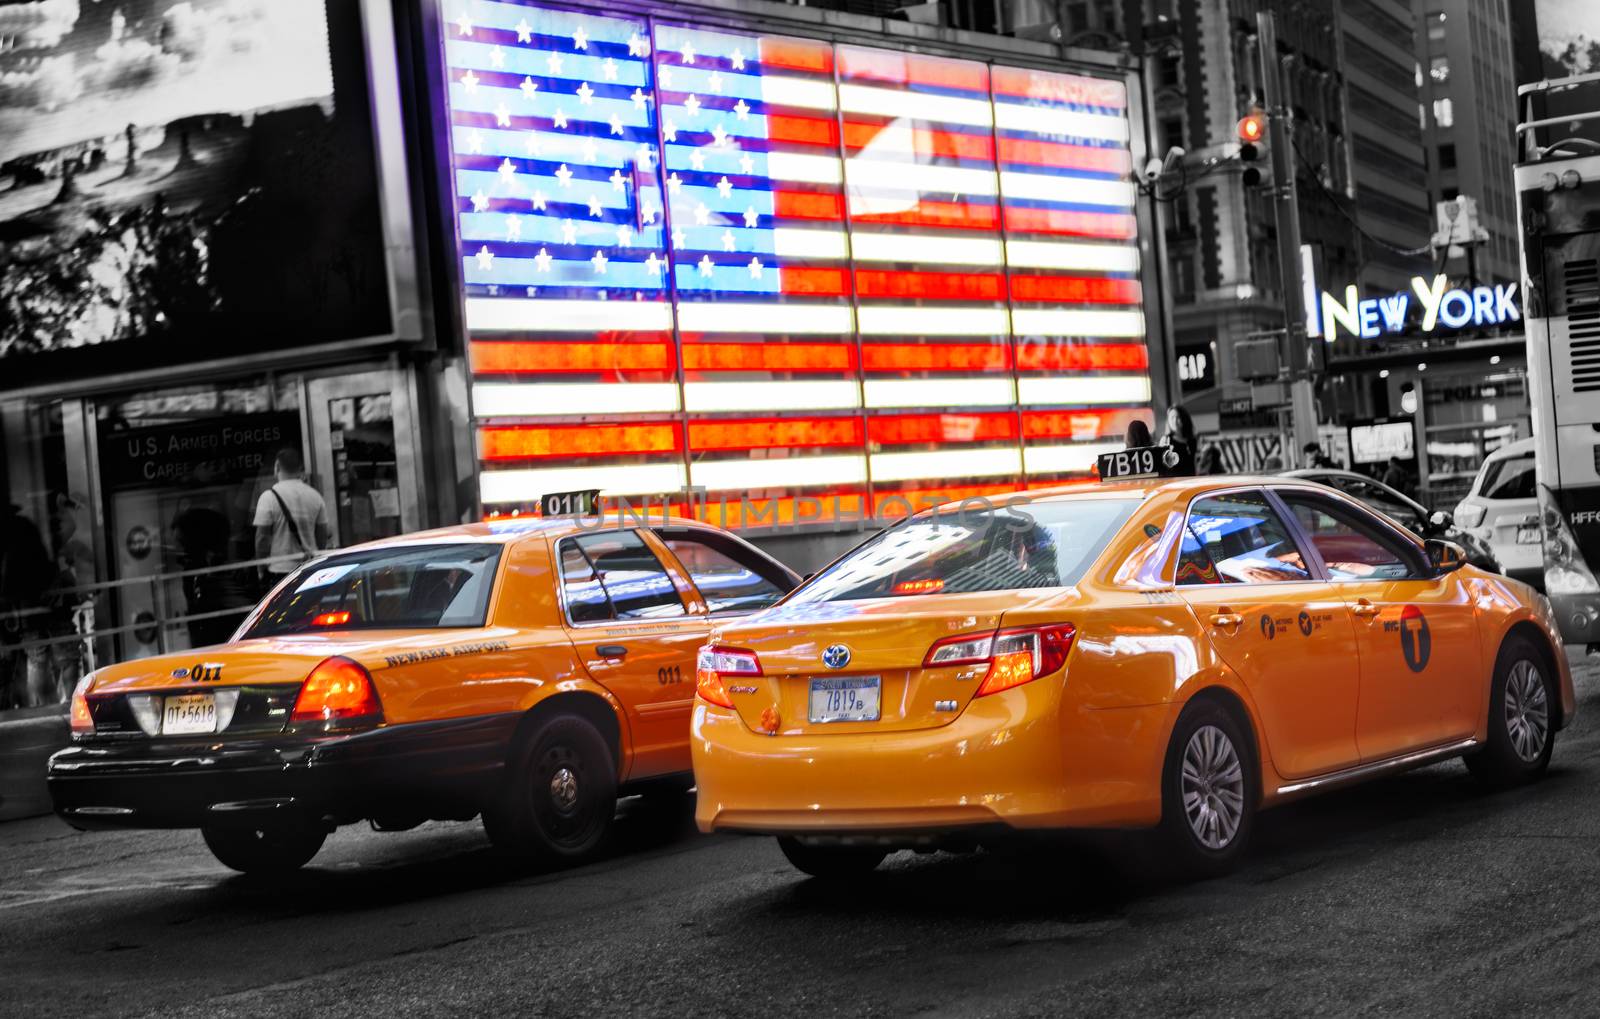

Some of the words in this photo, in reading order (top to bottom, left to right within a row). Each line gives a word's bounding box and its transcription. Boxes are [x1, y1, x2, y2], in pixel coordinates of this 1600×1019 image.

[1320, 283, 1409, 342] NEW
[1411, 273, 1520, 332] YORK
[128, 436, 163, 458] U.S.
[1103, 450, 1154, 477] 7B19
[548, 493, 585, 515] 011
[384, 647, 451, 668] NEWARK
[453, 640, 511, 657] AIRPORT
[191, 663, 224, 682] 011
[658, 664, 682, 685] 011
